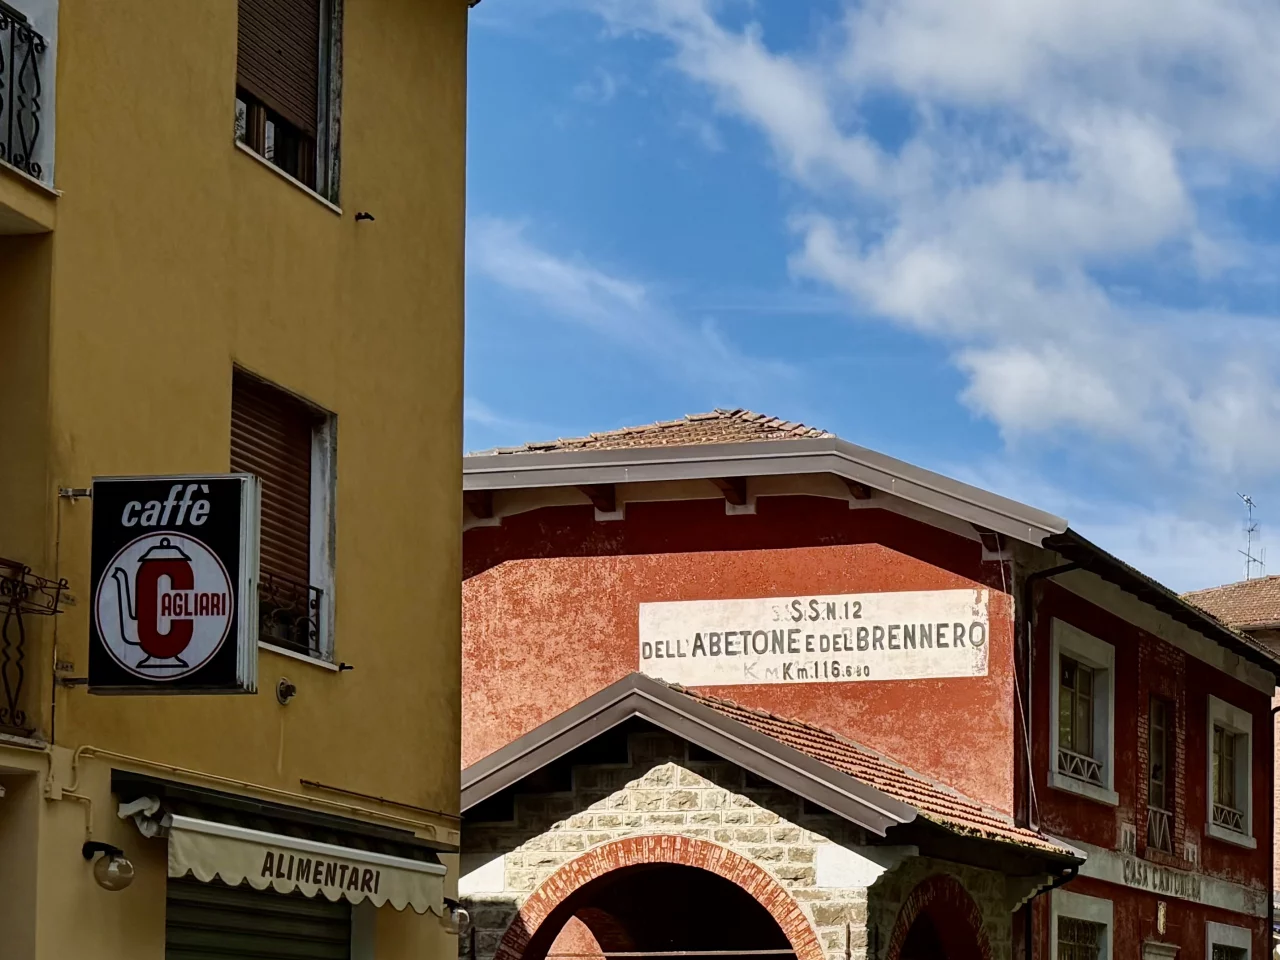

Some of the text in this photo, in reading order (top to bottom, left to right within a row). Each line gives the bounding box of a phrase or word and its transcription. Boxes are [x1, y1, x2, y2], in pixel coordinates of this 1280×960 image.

[121, 484, 210, 527] caffè
[805, 634, 815, 653] E
[820, 634, 853, 653] DEL
[856, 621, 986, 652] BRENNERO
[261, 851, 380, 894] ALIMENTARI
